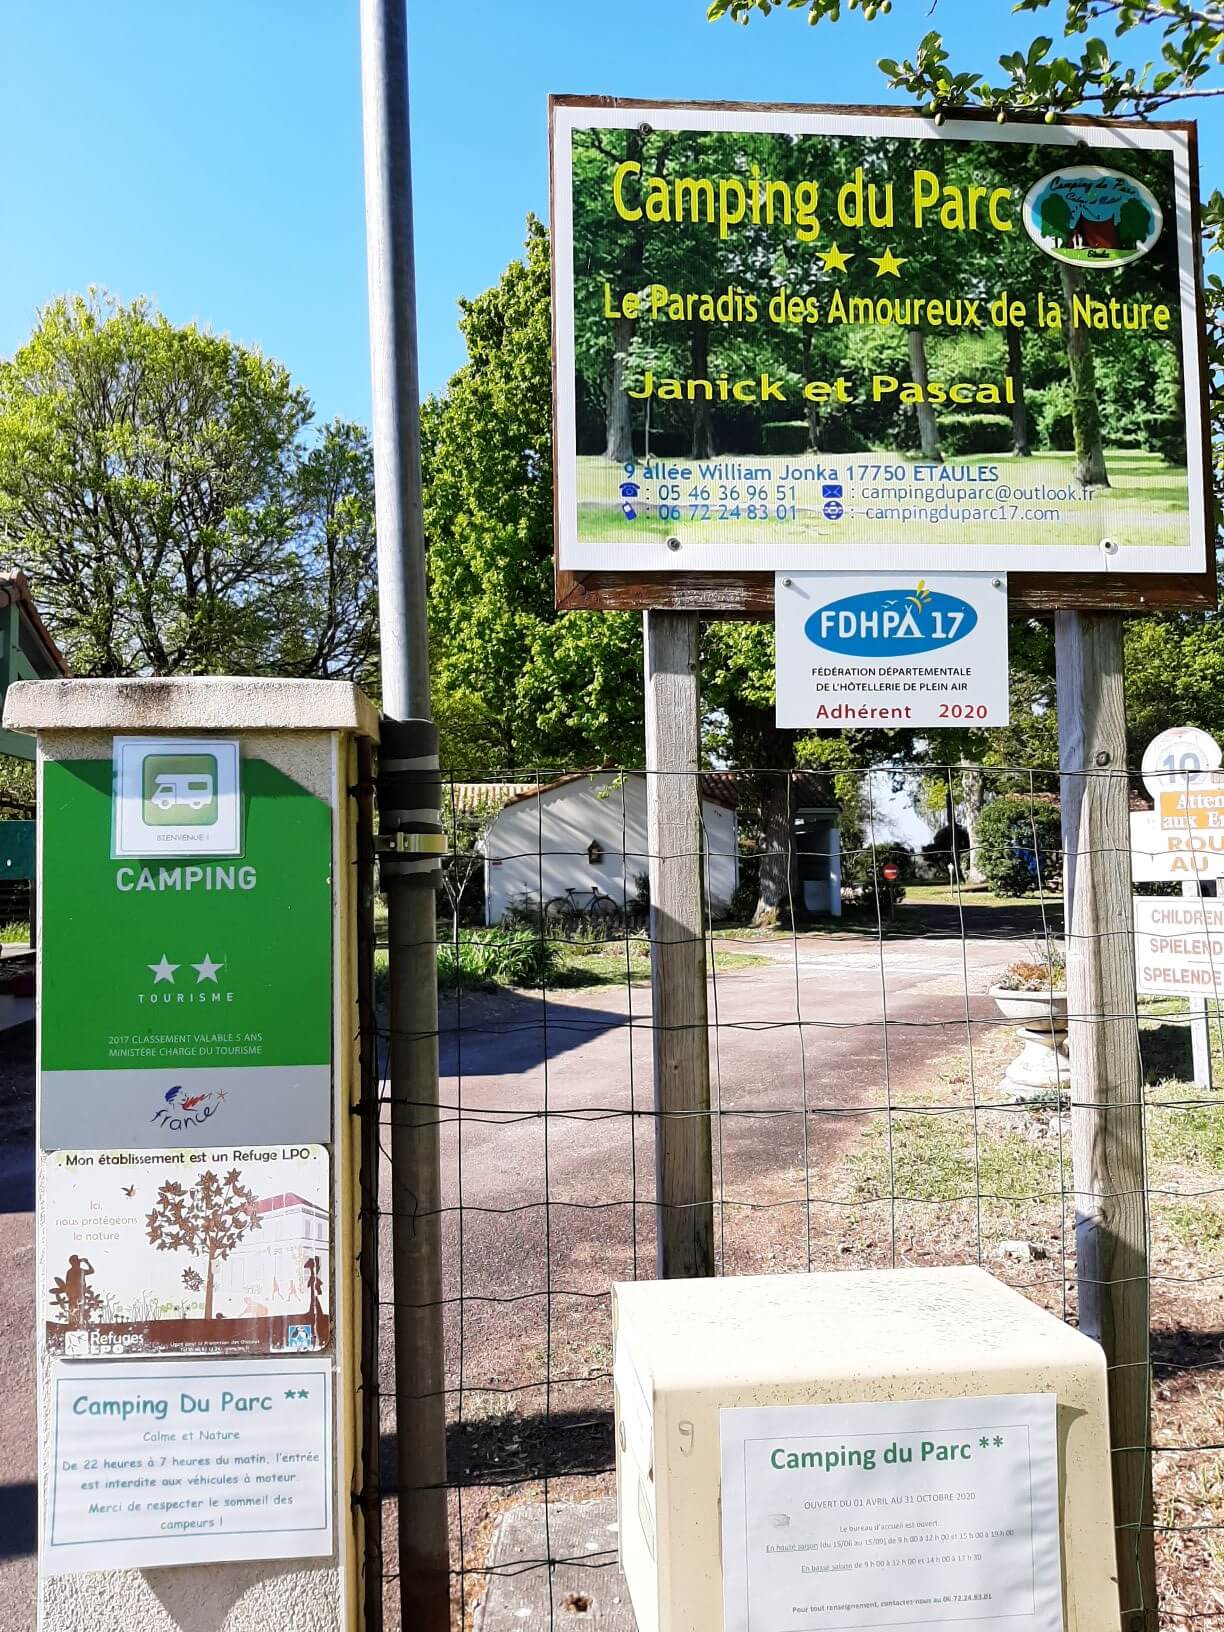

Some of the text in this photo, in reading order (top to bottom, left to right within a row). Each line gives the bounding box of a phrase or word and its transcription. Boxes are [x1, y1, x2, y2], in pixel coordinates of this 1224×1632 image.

[613, 160, 1013, 241] Camping du Parc
[604, 282, 1171, 331] Le Paradis des Amoureux de la Nature
[628, 371, 1016, 404] Janick et Pascal
[624, 463, 999, 482] 9 allée William Jonka 17750 ETAULES
[658, 484, 796, 501] 05 46 36 96 51
[861, 484, 1096, 503] campingduparc@outlook.fr
[658, 504, 797, 521] 06 72 24 83 01
[865, 505, 1060, 523] campingduparc17.com
[820, 605, 965, 639] FDHPA 17
[811, 666, 972, 677] FÉDÉRATION DÉPARTEMENTALE
[816, 681, 968, 692] DE L'HÔTELLERIE DE PLEIN AIR
[816, 703, 988, 719] Adhérent 2020
[1162, 752, 1201, 784] 10
[156, 833, 204, 842] BIENVENUE
[1170, 856, 1209, 872] AU
[116, 866, 257, 891] CAMPING
[1151, 909, 1224, 926] CHILDREN
[138, 992, 234, 1003] TOURISME
[108, 1033, 263, 1045] 2017 CLASSEMENT VALABLE 5 ANS
[199, 1047, 213, 1056] DU
[215, 1046, 262, 1055] TOURISME
[150, 1101, 221, 1131] france
[65, 1148, 310, 1167] Mon établissement est un Refuge LPO
[81, 1215, 138, 1227] protégeons
[73, 1231, 120, 1241] la nature
[90, 1332, 144, 1345] Refuges
[73, 1391, 273, 1421] Camping Du Parc
[143, 1430, 240, 1442] Calme et Nature
[62, 1460, 78, 1471] De
[84, 1459, 98, 1470] 22
[103, 1458, 142, 1469] heures
[147, 1456, 155, 1467] à
[160, 1457, 167, 1467] 7
[172, 1456, 211, 1466] heures
[216, 1455, 230, 1466] du
[276, 1452, 320, 1463] l'entrée
[770, 1440, 972, 1472] Camping du Parc
[80, 1472, 296, 1490] est interdite aux véhicules à moteur
[88, 1494, 294, 1514] Merci de respecter le sommeil des
[804, 1492, 976, 1510] OUVERT DU 01 AVRIL AU 31 OCTOBRE 2020
[160, 1518, 215, 1531] campeurs
[840, 1525, 848, 1533] Le
[849, 1524, 873, 1532] bureau
[905, 1521, 915, 1529] est
[792, 1606, 809, 1614] Pour
[810, 1605, 825, 1613] tout
